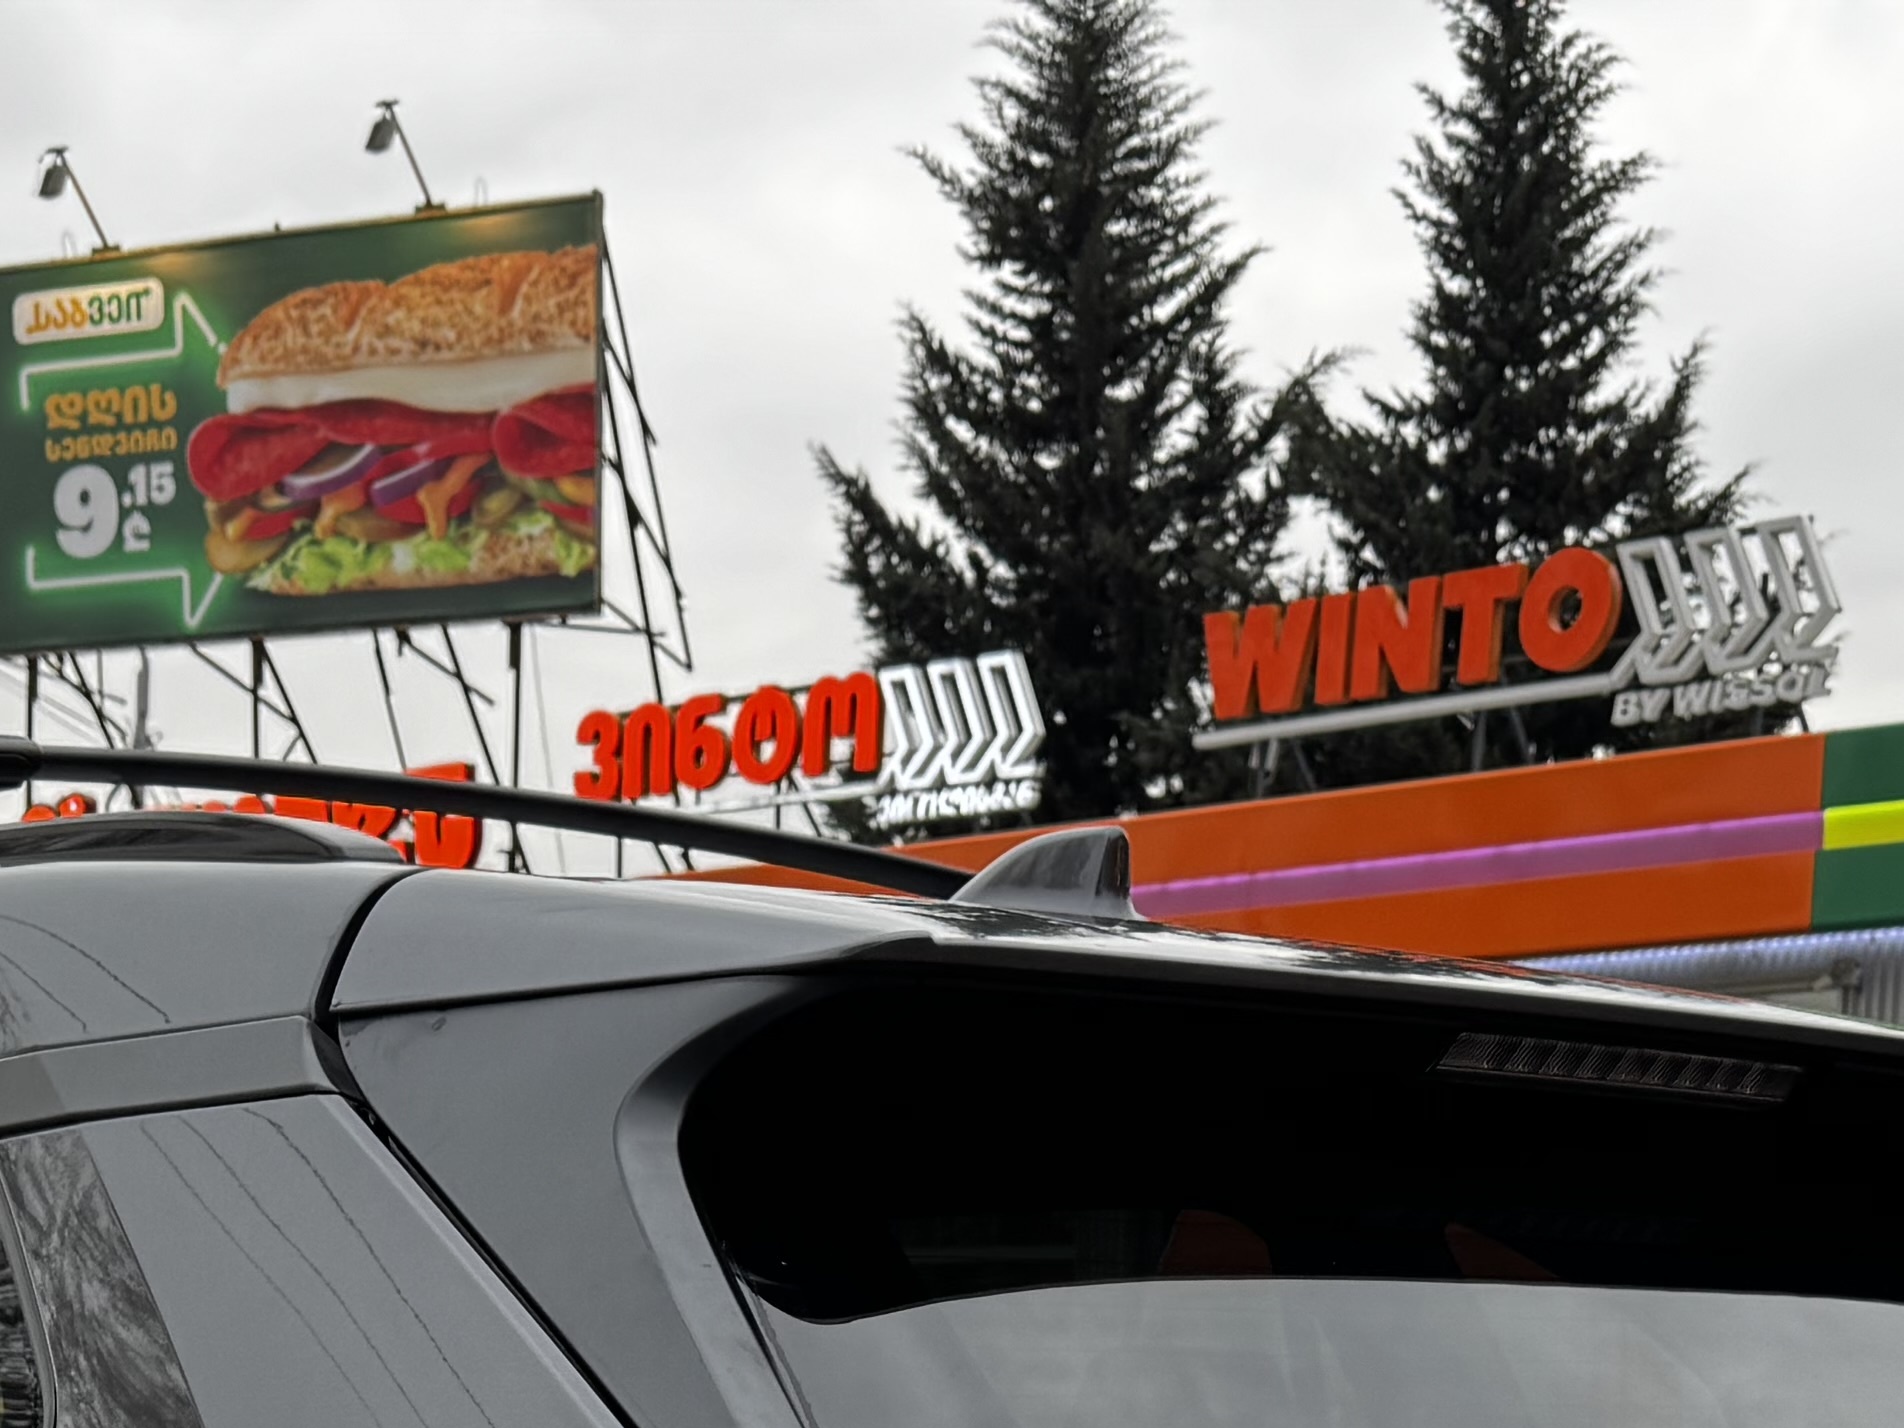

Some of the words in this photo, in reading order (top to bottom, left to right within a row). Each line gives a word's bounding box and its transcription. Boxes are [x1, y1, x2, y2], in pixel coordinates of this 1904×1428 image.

[25, 286, 151, 335] საბვეი
[45, 383, 177, 430] დღის
[1203, 547, 1623, 721] WINTO
[1610, 687, 1672, 728] BY
[1672, 665, 1832, 720] WISSOL
[574, 672, 883, 801] ვინტო
